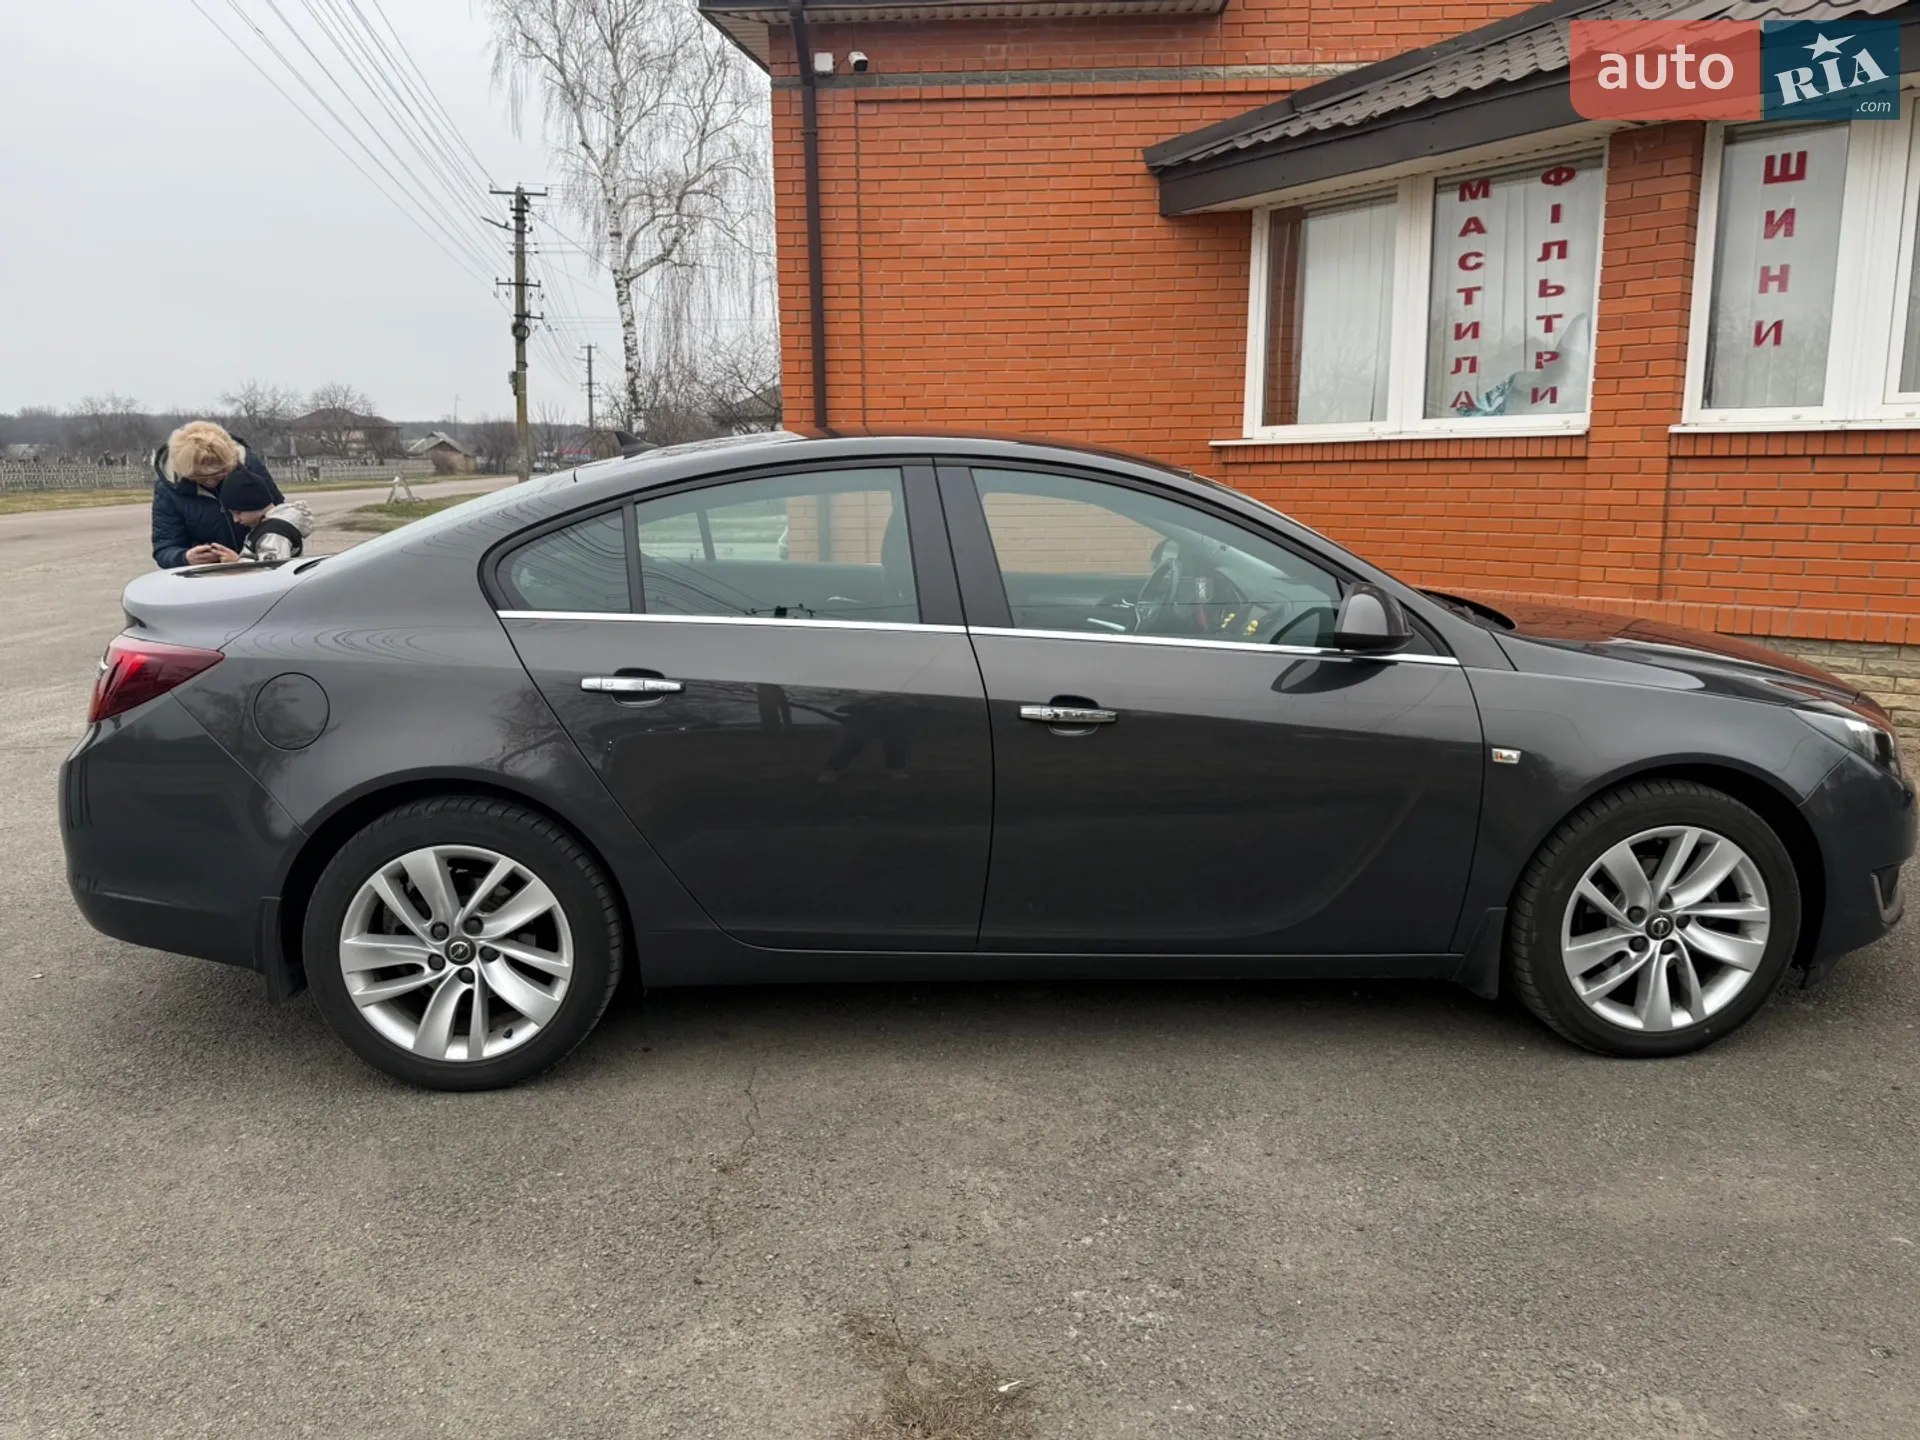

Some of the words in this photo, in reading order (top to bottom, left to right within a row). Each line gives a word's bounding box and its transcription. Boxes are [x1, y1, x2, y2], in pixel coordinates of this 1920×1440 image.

[1450, 178, 1492, 410] МАСТИЛА
[1530, 166, 1576, 405] ФІЛЬТРИ
[1753, 150, 1808, 347] ШИНИ
